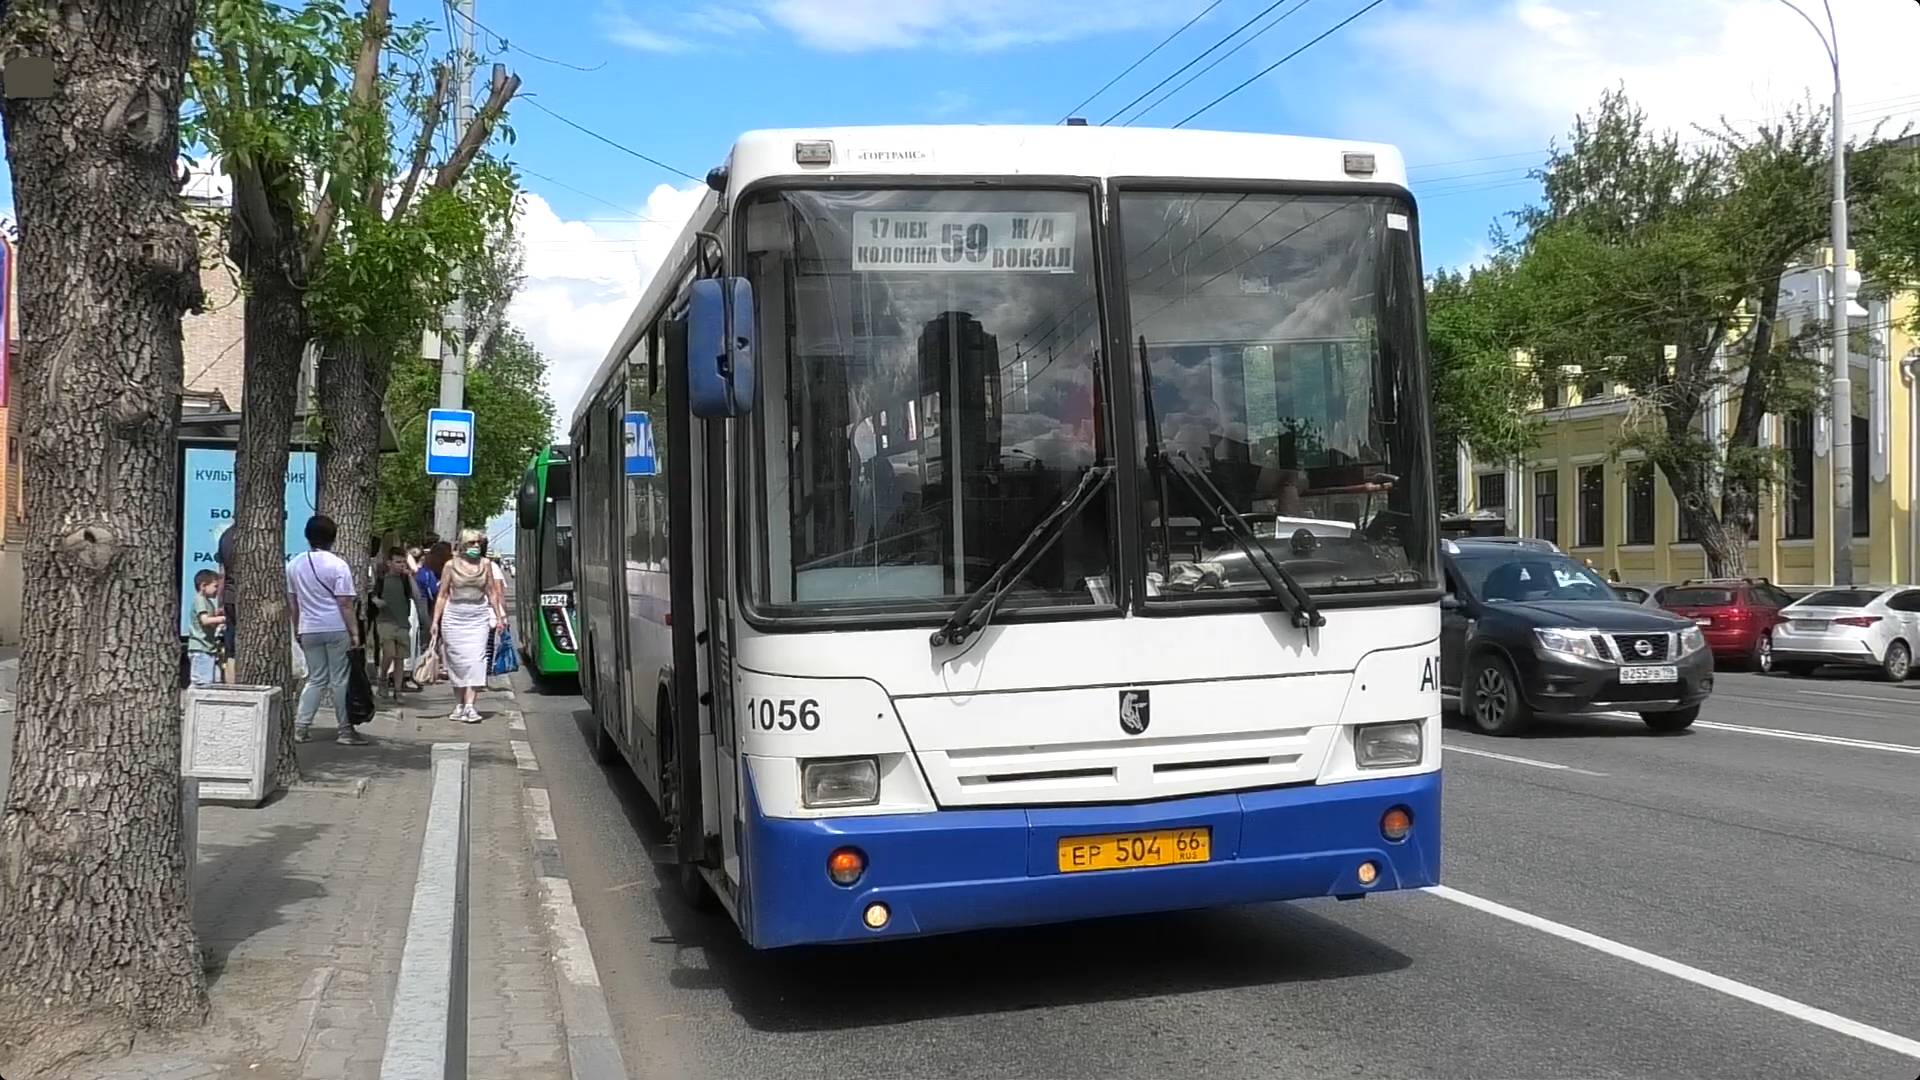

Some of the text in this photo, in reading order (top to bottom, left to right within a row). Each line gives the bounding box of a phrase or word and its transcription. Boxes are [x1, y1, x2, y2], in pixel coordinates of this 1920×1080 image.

[869, 217, 928, 240] 17 МЕХ
[1011, 218, 1055, 243] Ж/Д
[941, 223, 989, 264] 59
[992, 246, 1072, 269] ВОКЗАЛ
[542, 595, 565, 605] 1234
[747, 697, 821, 731] 1056
[1072, 831, 1200, 866] ЕР 504 66
[1179, 851, 1198, 860] RUS
